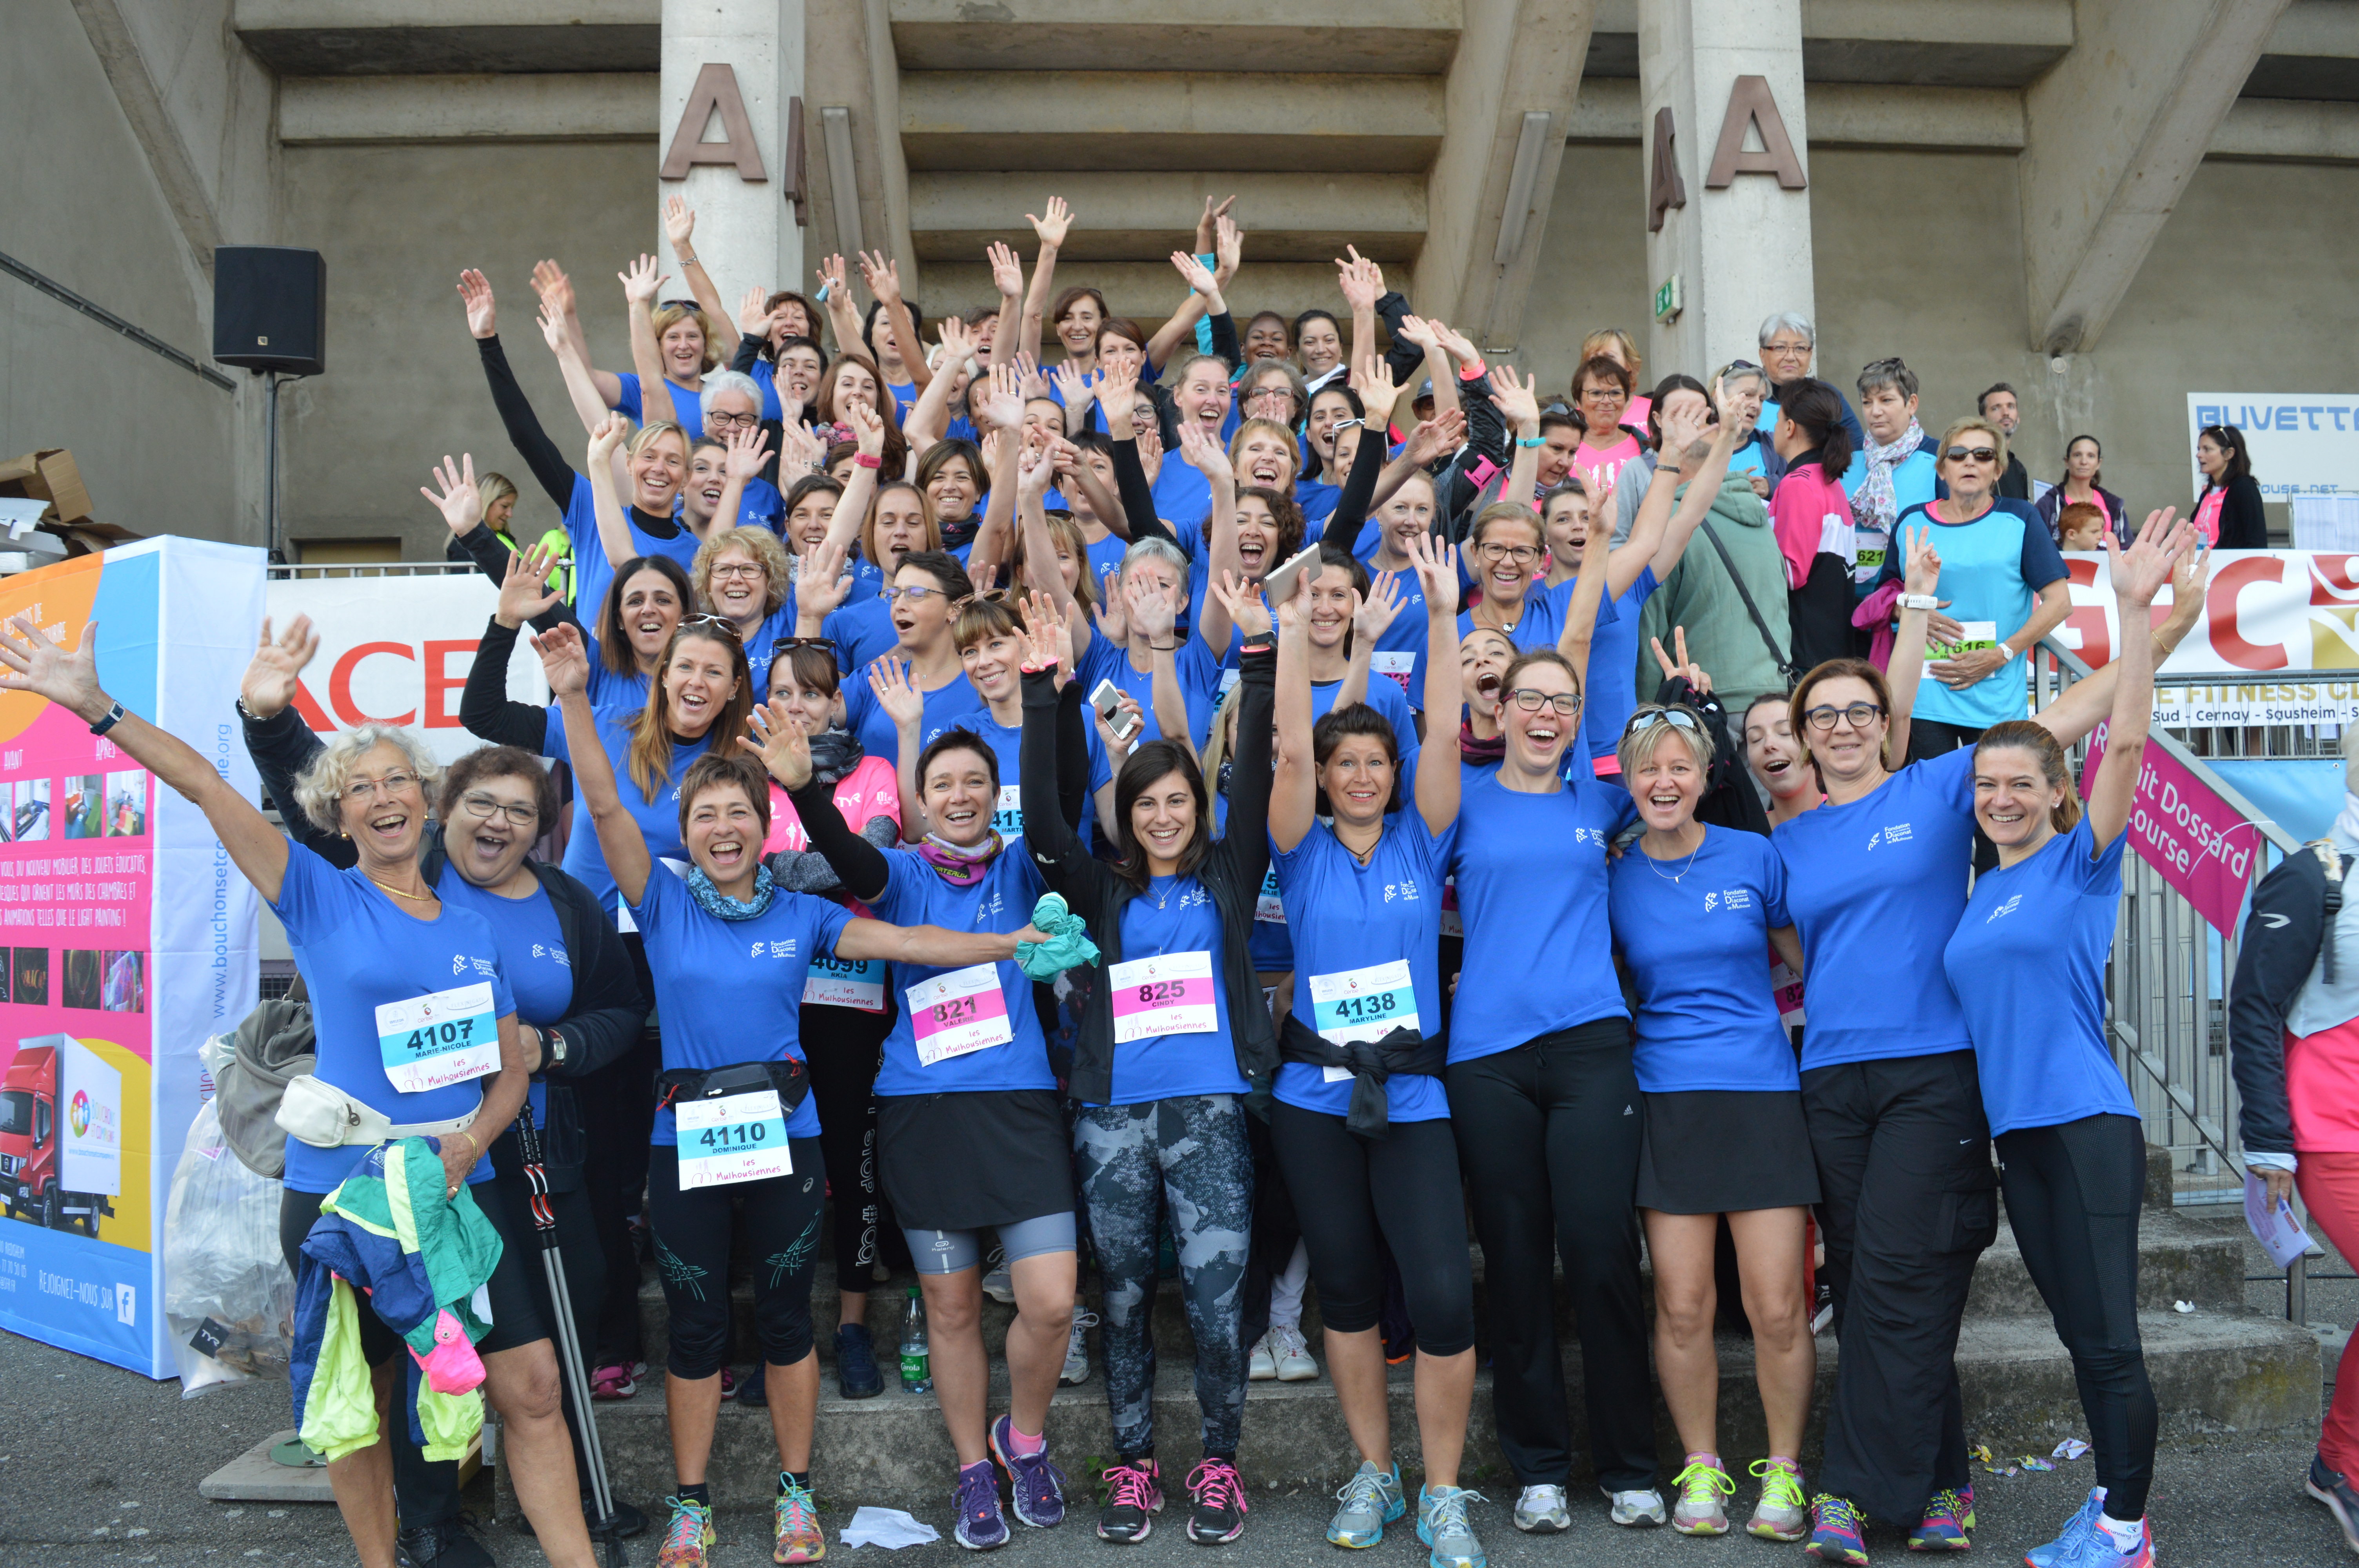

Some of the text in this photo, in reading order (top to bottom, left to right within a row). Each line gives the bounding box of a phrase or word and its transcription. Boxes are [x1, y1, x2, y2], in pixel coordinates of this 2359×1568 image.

[660, 63, 768, 182] A
[1705, 75, 1807, 190] A
[2196, 405, 2359, 431] BUVETT
[2187, 684, 2317, 703] FITNESS
[2153, 710, 2180, 722] Sud
[2196, 709, 2249, 725] Cernay
[837, 793, 861, 808] TYR
[1885, 823, 1910, 833] Fondation
[1885, 829, 1912, 839] Diaconat
[2128, 794, 2190, 874] ourse
[2160, 782, 2250, 879] Dossard
[26, 859, 51, 877] NOUVEAU
[81, 857, 92, 874] DES
[21, 884, 30, 902] QUI
[32, 884, 54, 901] ORNENT
[56, 884, 65, 900] LES
[67, 882, 83, 900] MURS
[85, 883, 95, 900] DES
[98, 881, 127, 900] CHAMBRES
[129, 882, 136, 900] ET
[1725, 896, 1749, 904] Diaconat
[37, 909, 54, 926] TELLES
[56, 909, 67, 926] QUE
[69, 909, 76, 926] LE
[78, 908, 93, 926] LIGHT
[819, 993, 874, 1006] Mulhousiennes
[843, 987, 854, 995] les
[1139, 980, 1185, 1002] 825
[933, 996, 977, 1023] 821
[1152, 999, 1175, 1007] CINDY
[1336, 993, 1396, 1018] 4138
[943, 1016, 974, 1027] VALÉRIE
[1349, 1013, 1387, 1024] MARYLINE
[407, 1018, 474, 1050] 4107
[1146, 1022, 1207, 1034] Mulhousiennes
[415, 1040, 472, 1058] MARIE-NICOLE
[946, 1034, 1003, 1055] Mulhousiennes
[454, 1059, 465, 1067] les
[428, 1062, 490, 1086] Mulhousiennes
[700, 1122, 765, 1147] 4110
[712, 1143, 757, 1154] DOMINIQUE
[716, 1165, 781, 1181] Mulhousiennes
[39, 1269, 113, 1311] REJOIGNEZ-NOUS SUR
[201, 1328, 220, 1347] TYR
[901, 1362, 920, 1372] Carola
[2107, 1528, 2131, 1539] running
